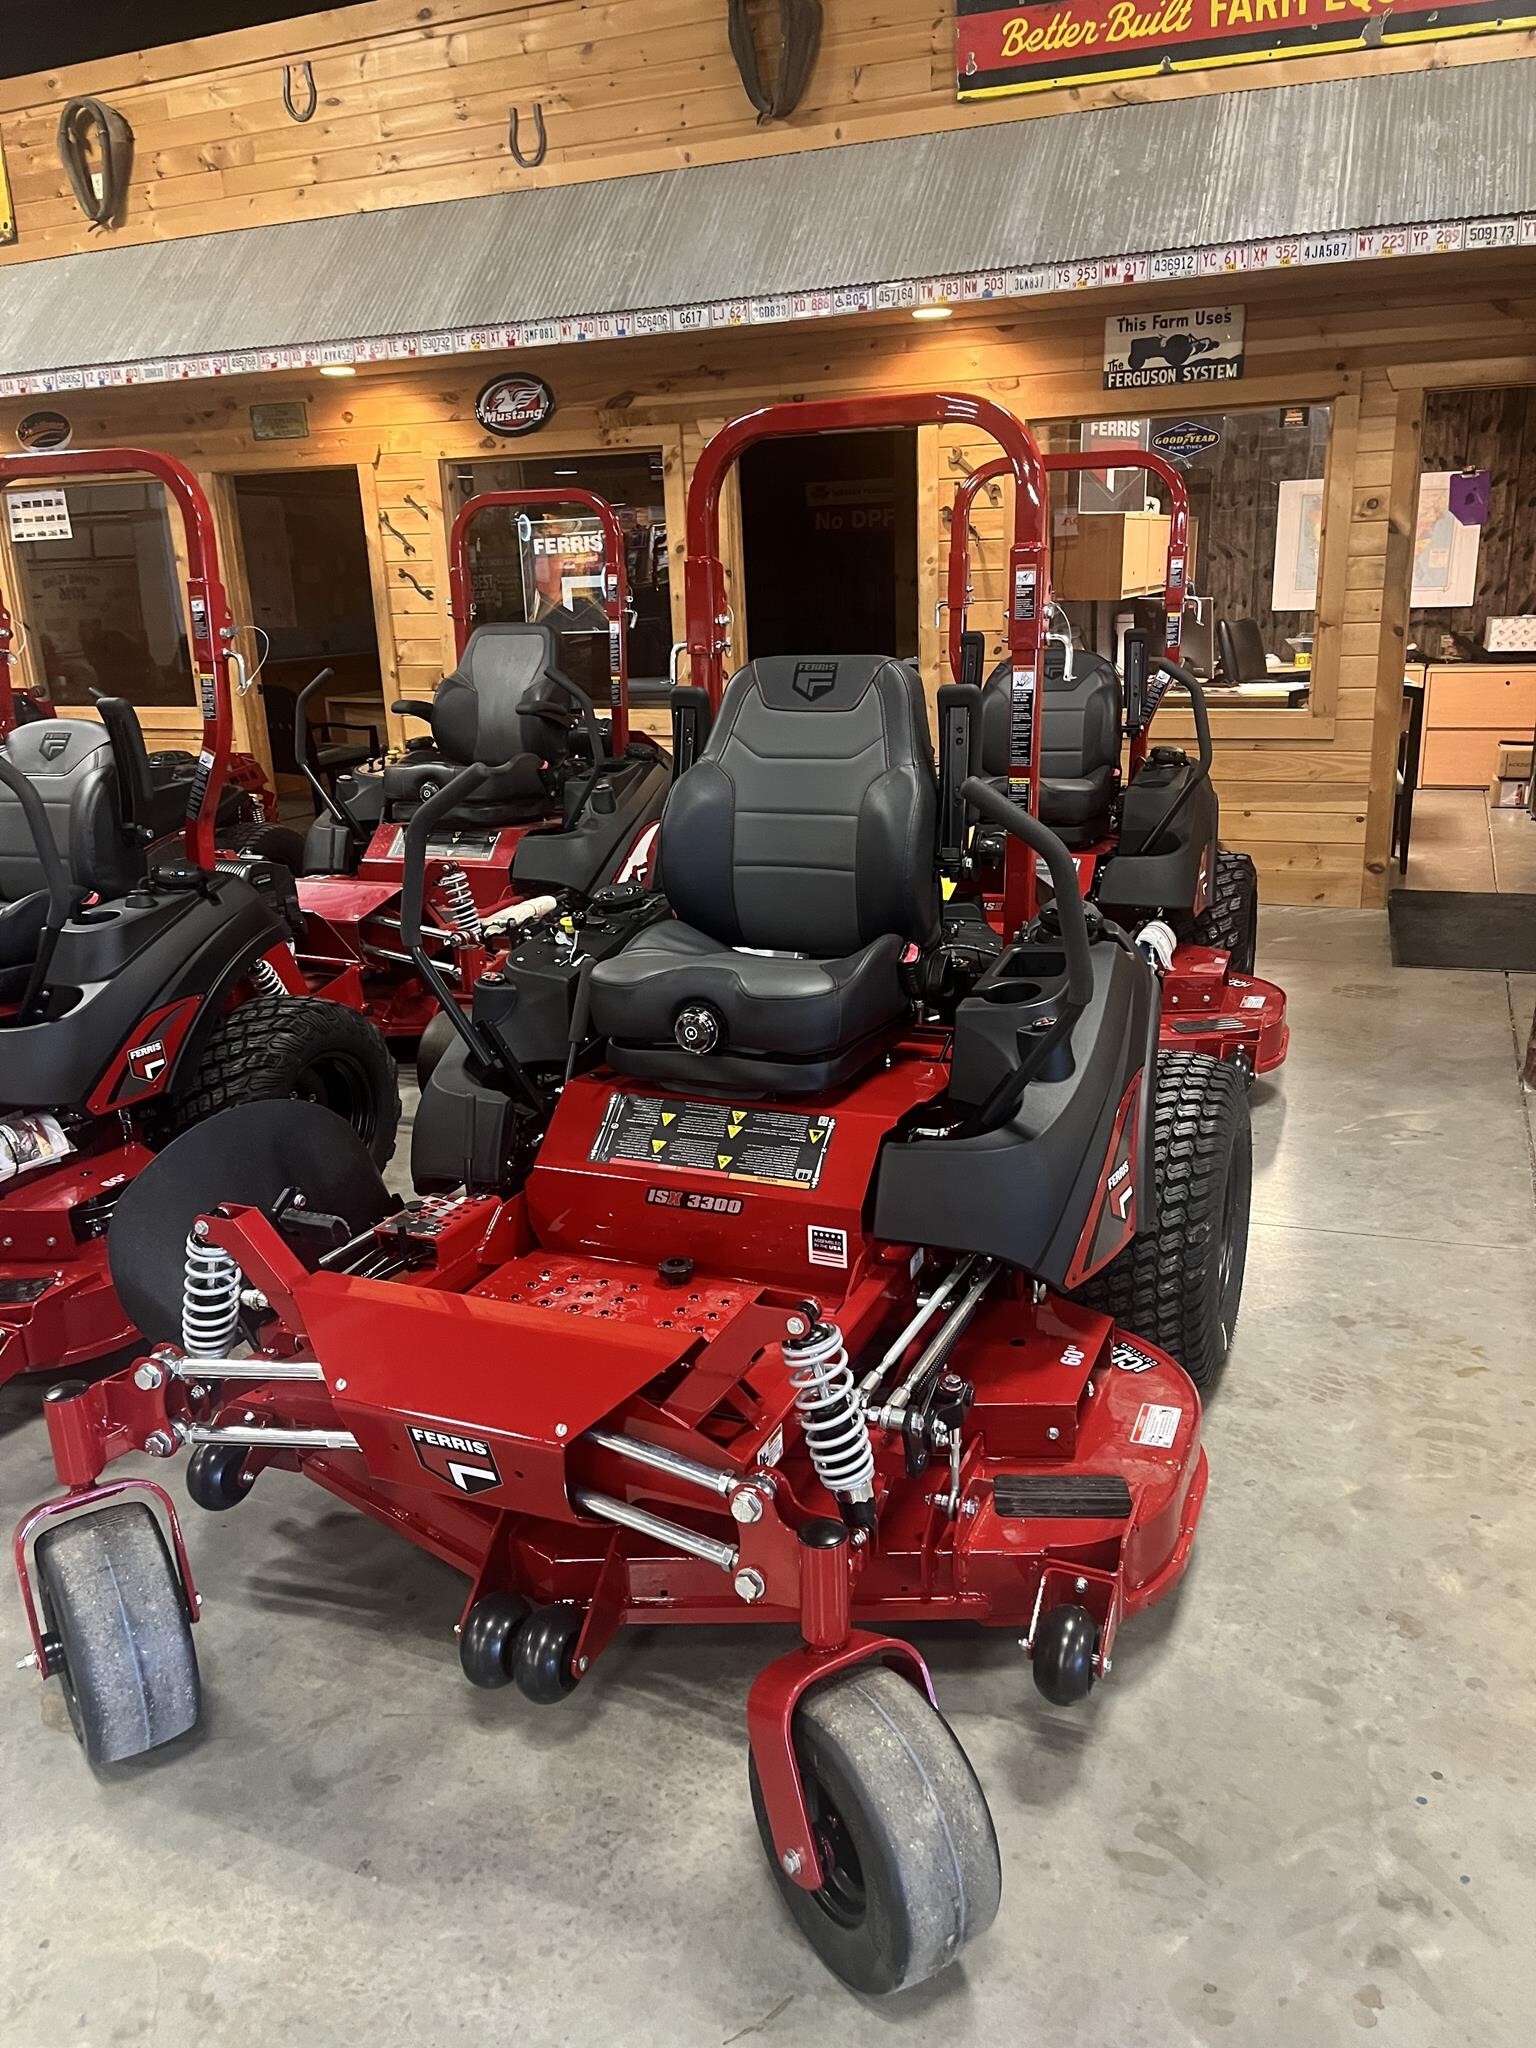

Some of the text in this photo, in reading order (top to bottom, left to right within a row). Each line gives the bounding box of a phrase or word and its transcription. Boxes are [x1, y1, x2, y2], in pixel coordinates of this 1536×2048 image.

[1001, 0, 1192, 57] Better-Built
[1414, 232, 1428, 245] YP
[1470, 225, 1514, 241] 509173
[1382, 235, 1405, 249] 223
[1203, 250, 1245, 267] YC 611
[1276, 244, 1298, 259] 352
[1304, 243, 1347, 259] 4JA587
[1125, 260, 1146, 276] 917
[1154, 256, 1194, 273] 436912
[1057, 266, 1098, 284] YS 953
[939, 282, 960, 297] 783
[984, 277, 1004, 291] 503
[680, 310, 702, 323] G617
[713, 309, 725, 320] LJ
[1117, 310, 1232, 333] This Farm Uses
[471, 333, 486, 345] 658
[505, 329, 521, 342] 927
[1107, 358, 1124, 372] The
[1108, 363, 1238, 388] FERGUSON SYSTEM
[483, 408, 541, 423] Mustang
[1090, 420, 1140, 437] FERRIS
[533, 535, 603, 555] FERRIS
[798, 663, 837, 671] FERRIS
[130, 1042, 162, 1060] FERRIS
[1107, 1160, 1129, 1191] FERRIS
[647, 1188, 742, 1215] ISX 3300
[813, 1237, 842, 1246] ASSEMBLED
[411, 1428, 487, 1456] FERRIS
